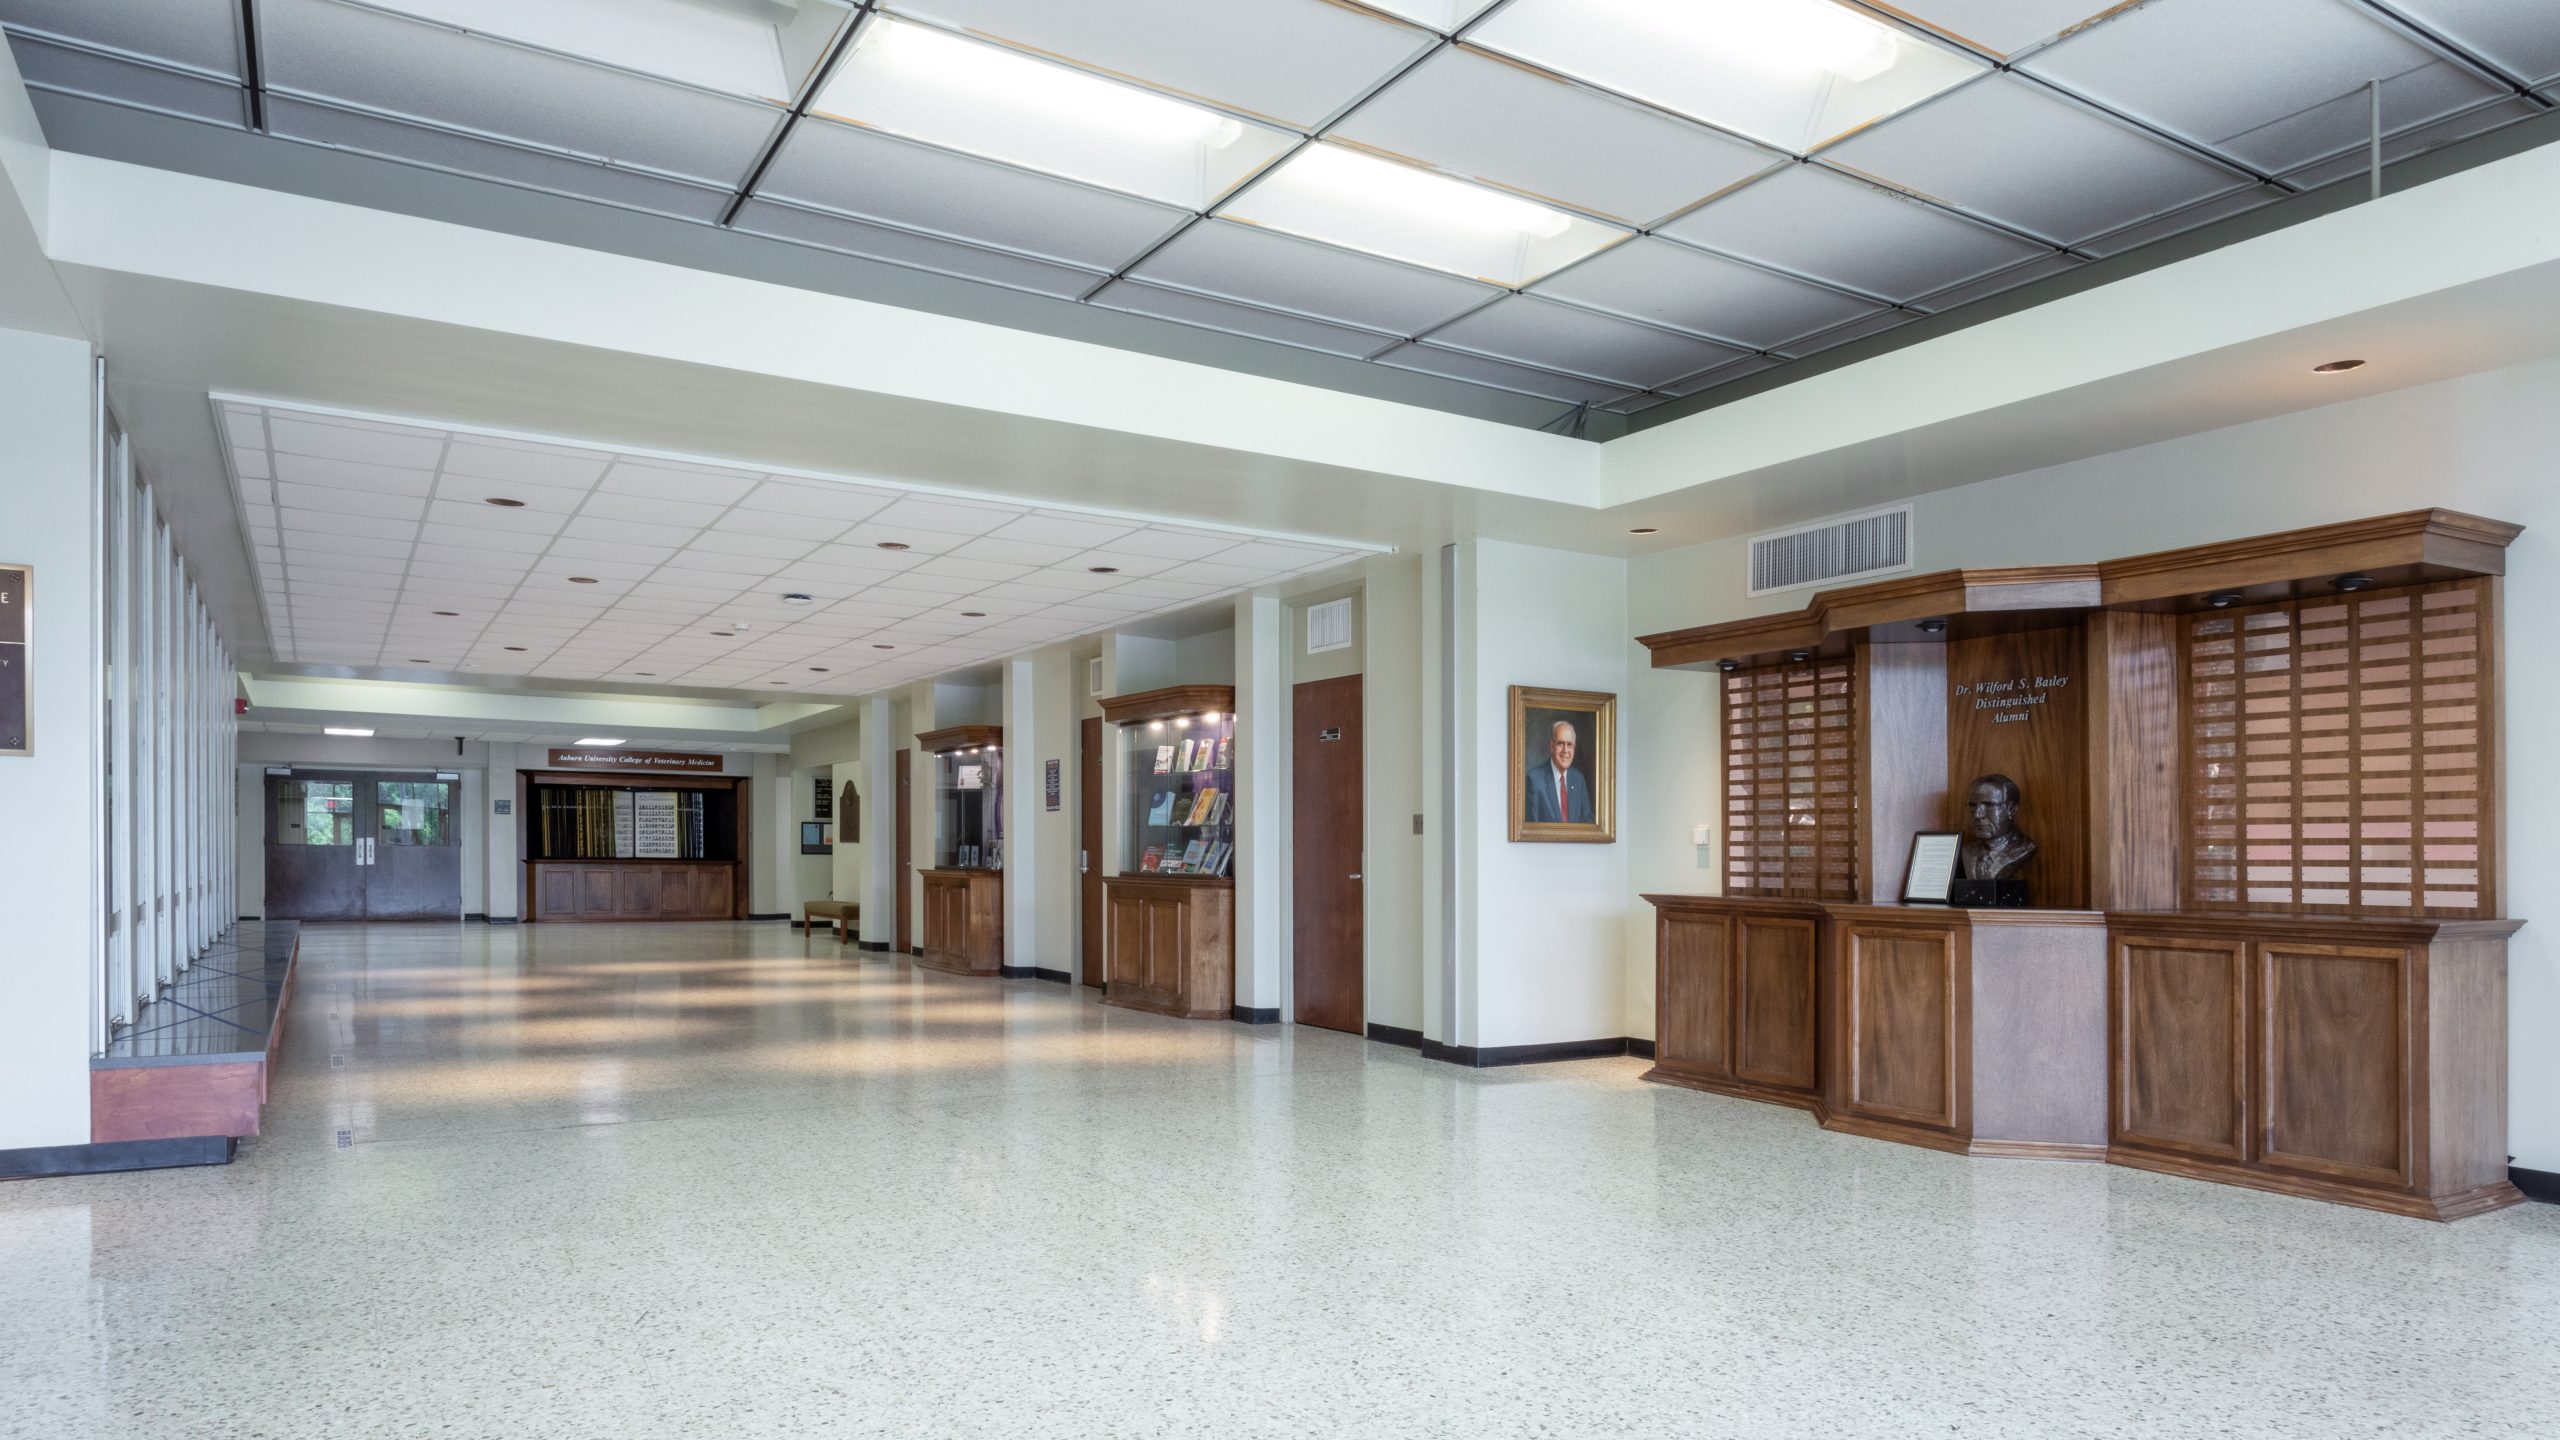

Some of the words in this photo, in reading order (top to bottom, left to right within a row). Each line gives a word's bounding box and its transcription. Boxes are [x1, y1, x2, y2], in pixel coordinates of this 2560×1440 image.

[1956, 685, 1972, 695] Dr.
[1976, 680, 2013, 694] Wilford
[2018, 678, 2029, 689] S.
[2035, 675, 2068, 687] Bailey
[1976, 693, 2046, 709] Distinguished
[1992, 710, 2029, 723] Alumni
[558, 754, 583, 762] Auburn
[584, 754, 617, 764] University
[619, 756, 643, 765] College
[644, 757, 652, 765] of
[654, 757, 686, 766] Veterinary
[688, 758, 715, 766] Medicine
